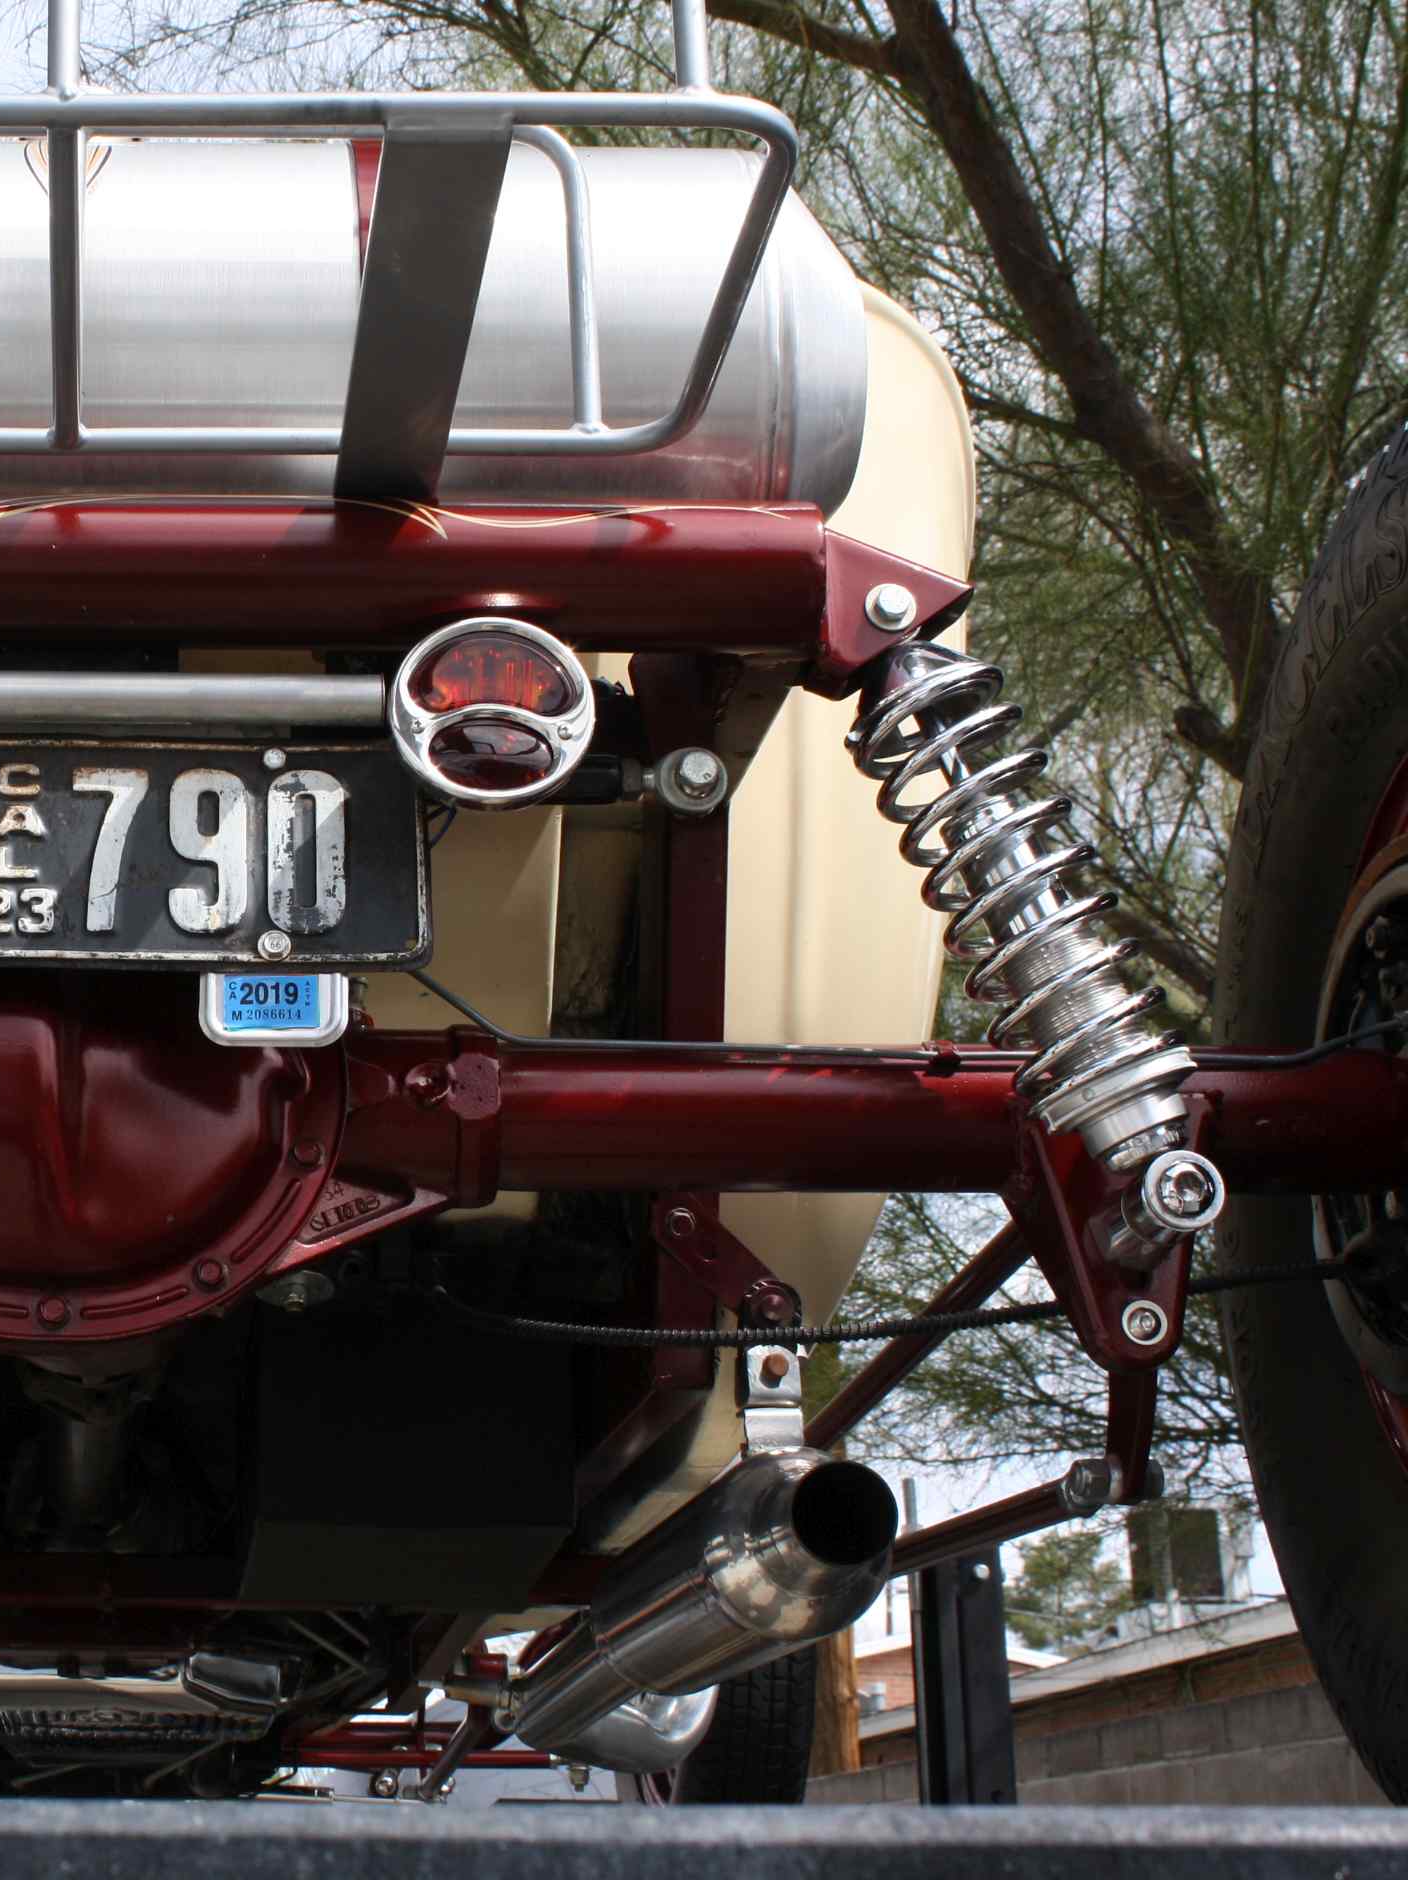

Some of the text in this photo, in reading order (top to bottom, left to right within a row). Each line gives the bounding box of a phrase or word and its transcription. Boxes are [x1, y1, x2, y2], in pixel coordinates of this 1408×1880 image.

[228, 981, 300, 1005] CA 2019
[231, 1009, 302, 1021] M 2086614
